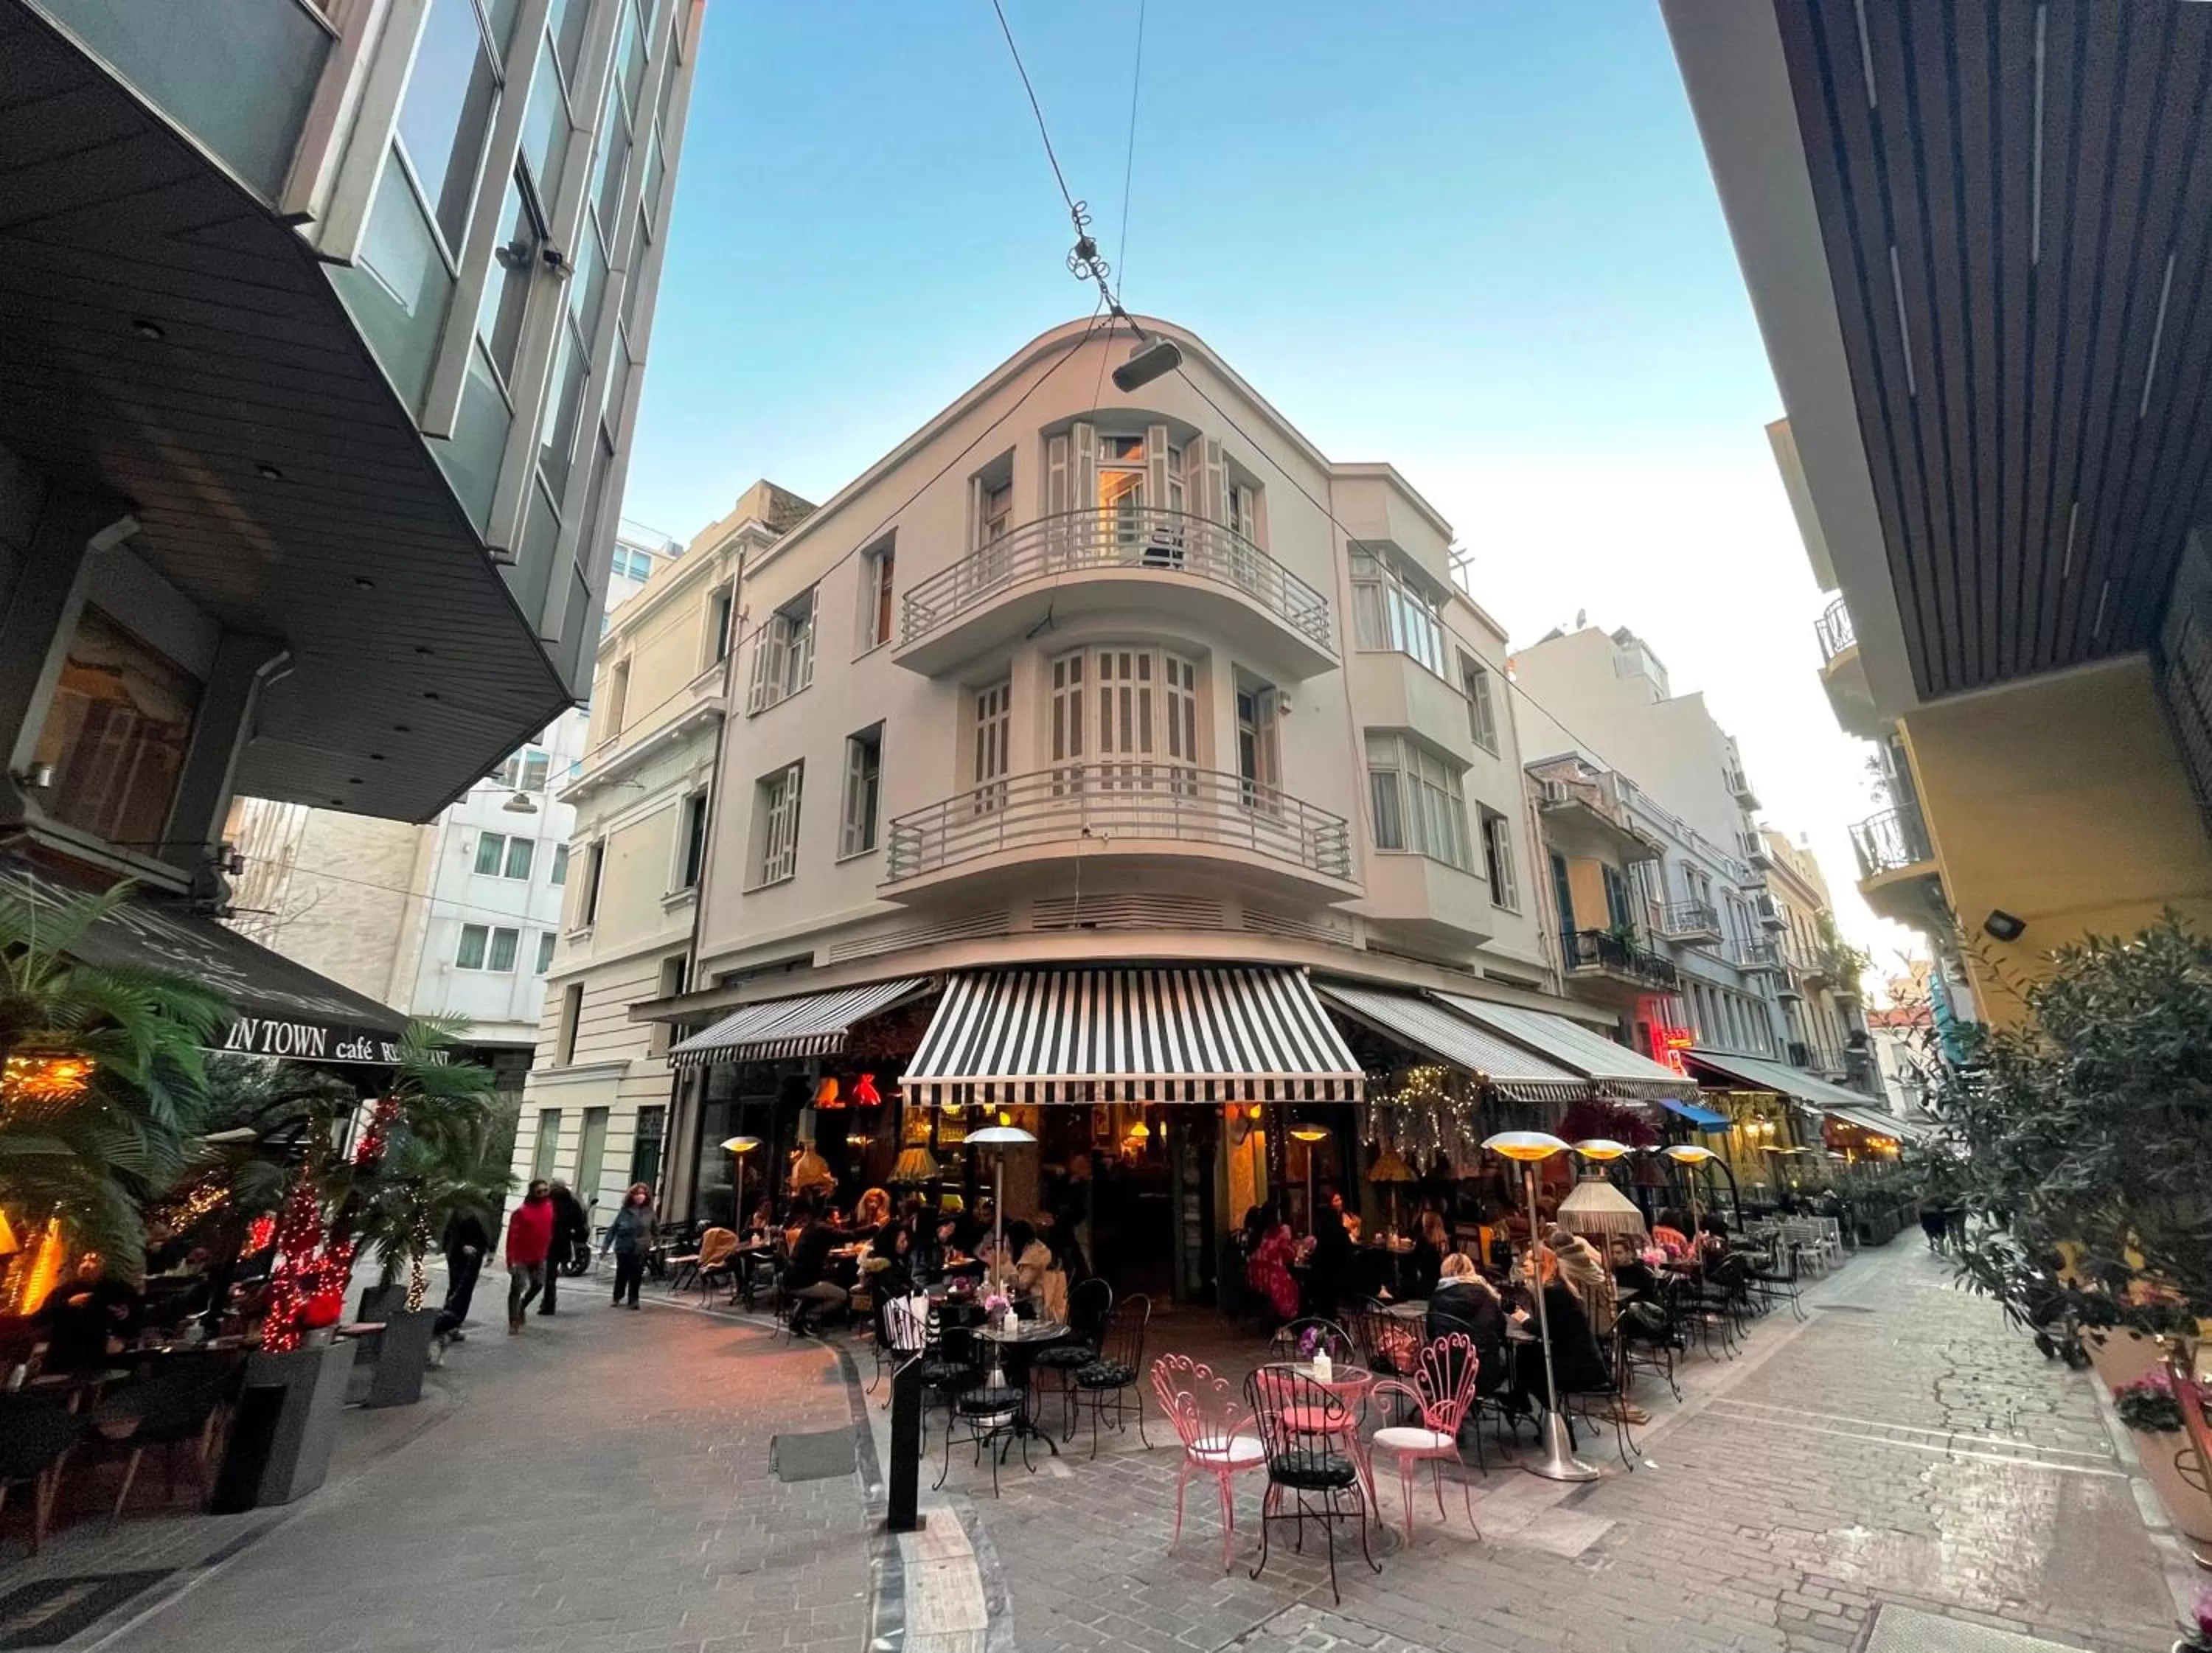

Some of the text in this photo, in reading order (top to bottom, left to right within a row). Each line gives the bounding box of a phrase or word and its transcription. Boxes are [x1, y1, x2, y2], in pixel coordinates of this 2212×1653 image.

[223, 1017, 260, 1051] IN
[261, 1020, 327, 1057] TOWN
[335, 1036, 373, 1060] café
